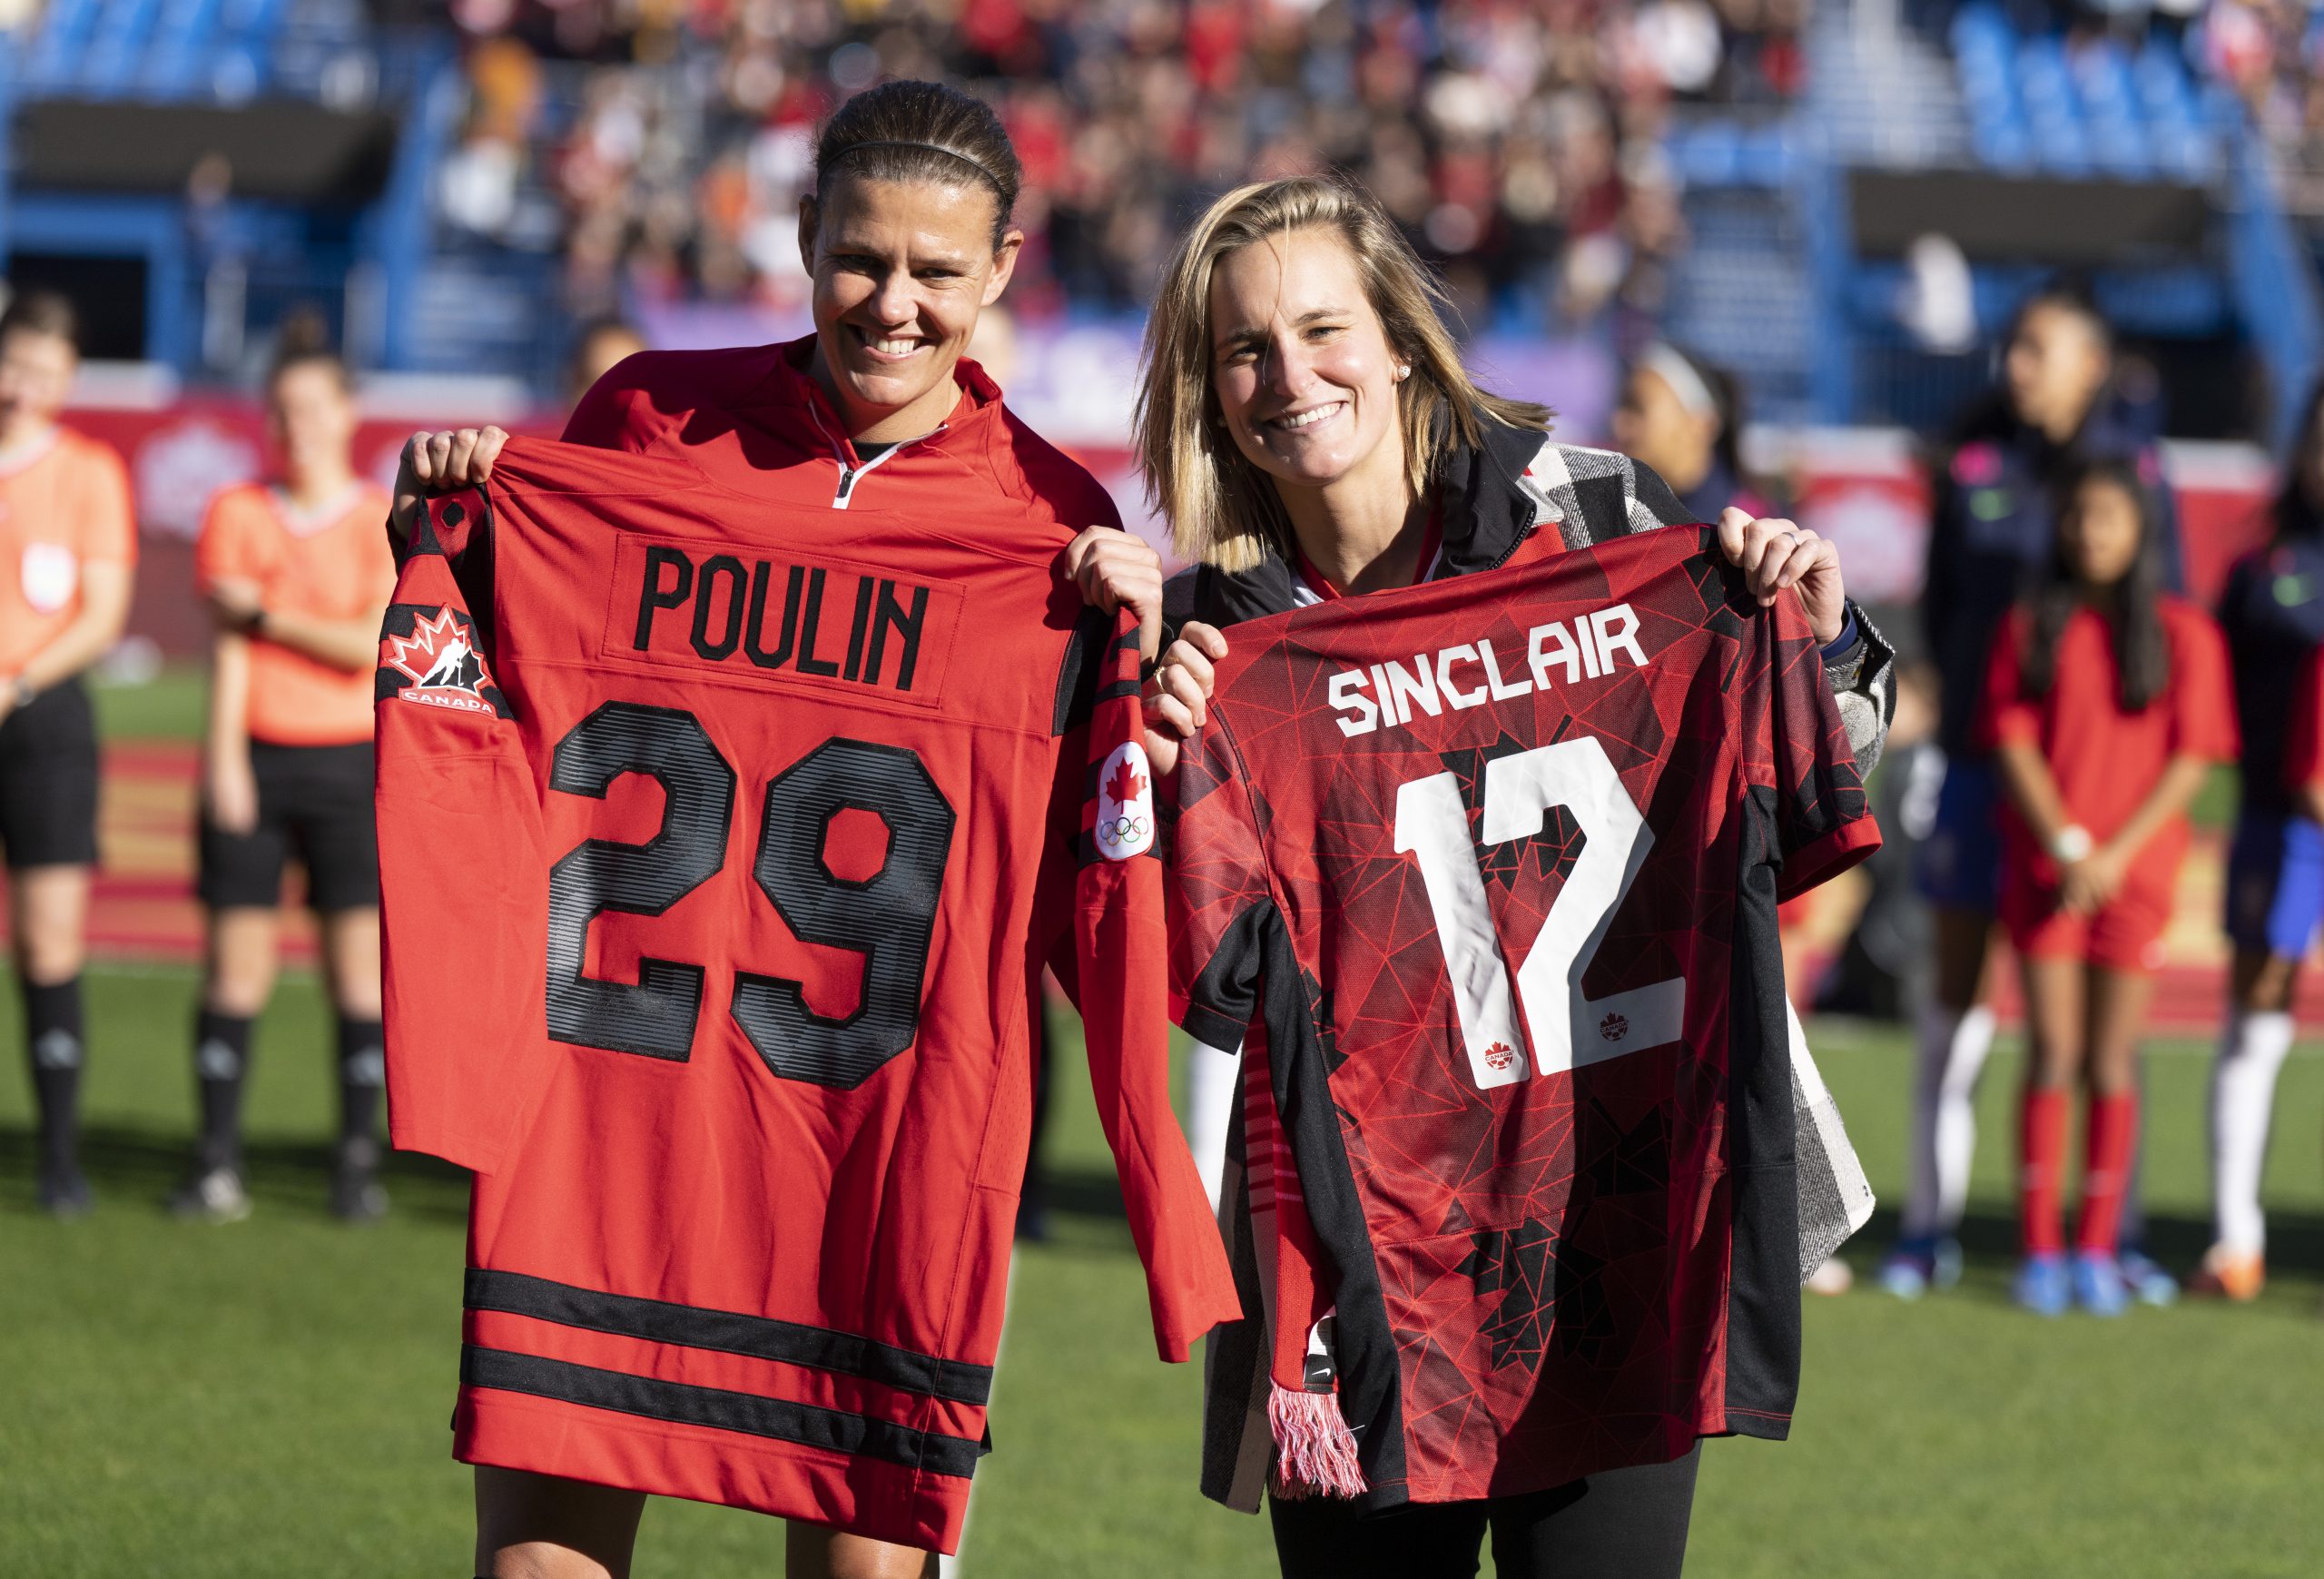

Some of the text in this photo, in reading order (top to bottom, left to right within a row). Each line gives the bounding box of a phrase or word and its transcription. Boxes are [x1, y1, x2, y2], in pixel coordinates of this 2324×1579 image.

[633, 545, 930, 691] POULIN
[1328, 603, 1649, 737] SINCLAIR
[404, 692, 493, 714] CANADA
[546, 700, 957, 1090] 29
[1394, 736, 1686, 1090] 12
[1484, 1051, 1513, 1061] CANADA
[1600, 1021, 1628, 1032] CANADA
